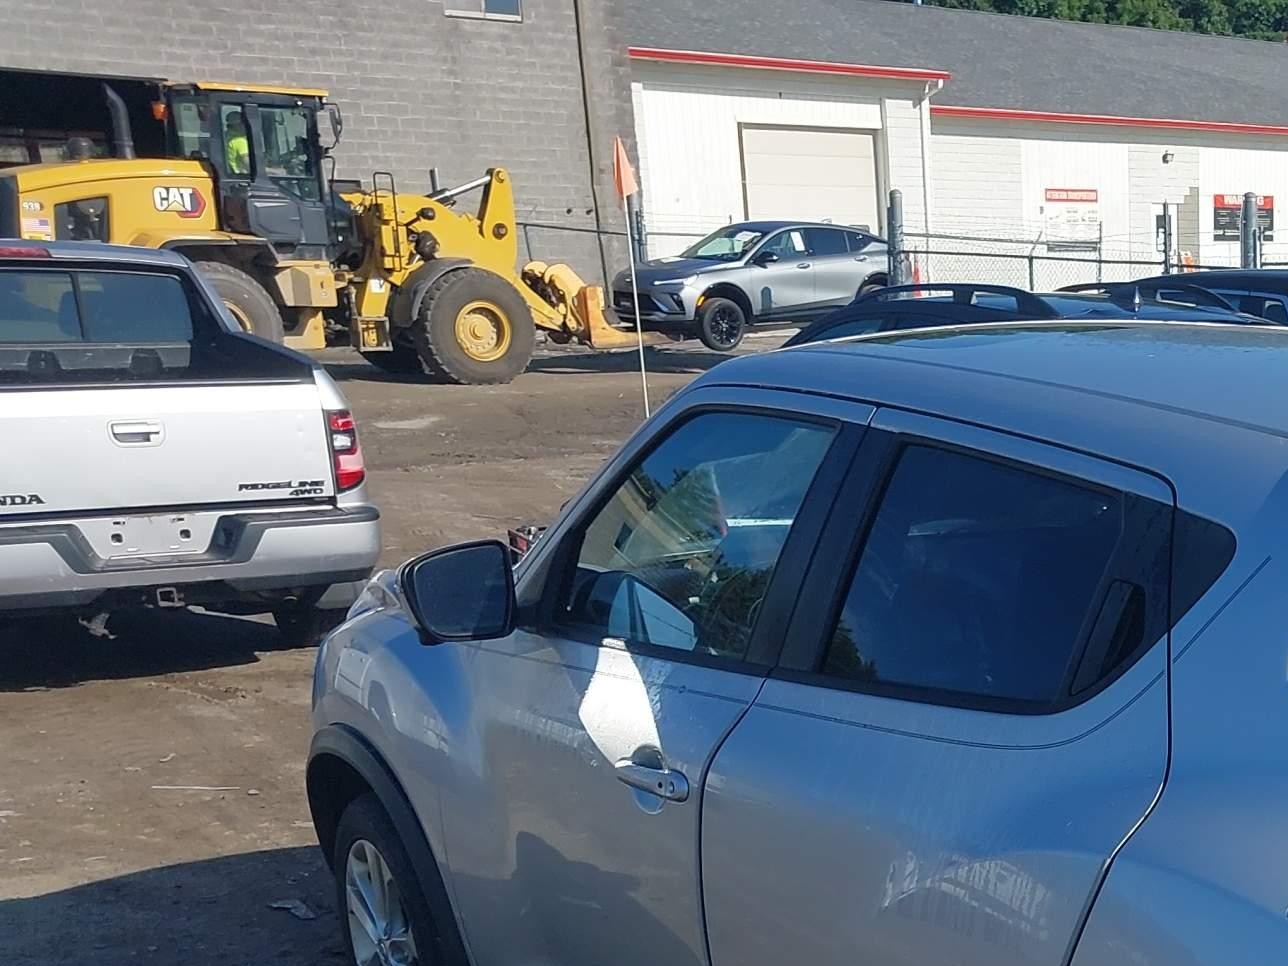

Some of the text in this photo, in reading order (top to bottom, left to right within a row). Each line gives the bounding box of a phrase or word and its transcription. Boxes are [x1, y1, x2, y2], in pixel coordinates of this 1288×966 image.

[153, 186, 193, 211] CAT
[1223, 194, 1265, 206] WARG
[288, 488, 324, 496] 4WD
